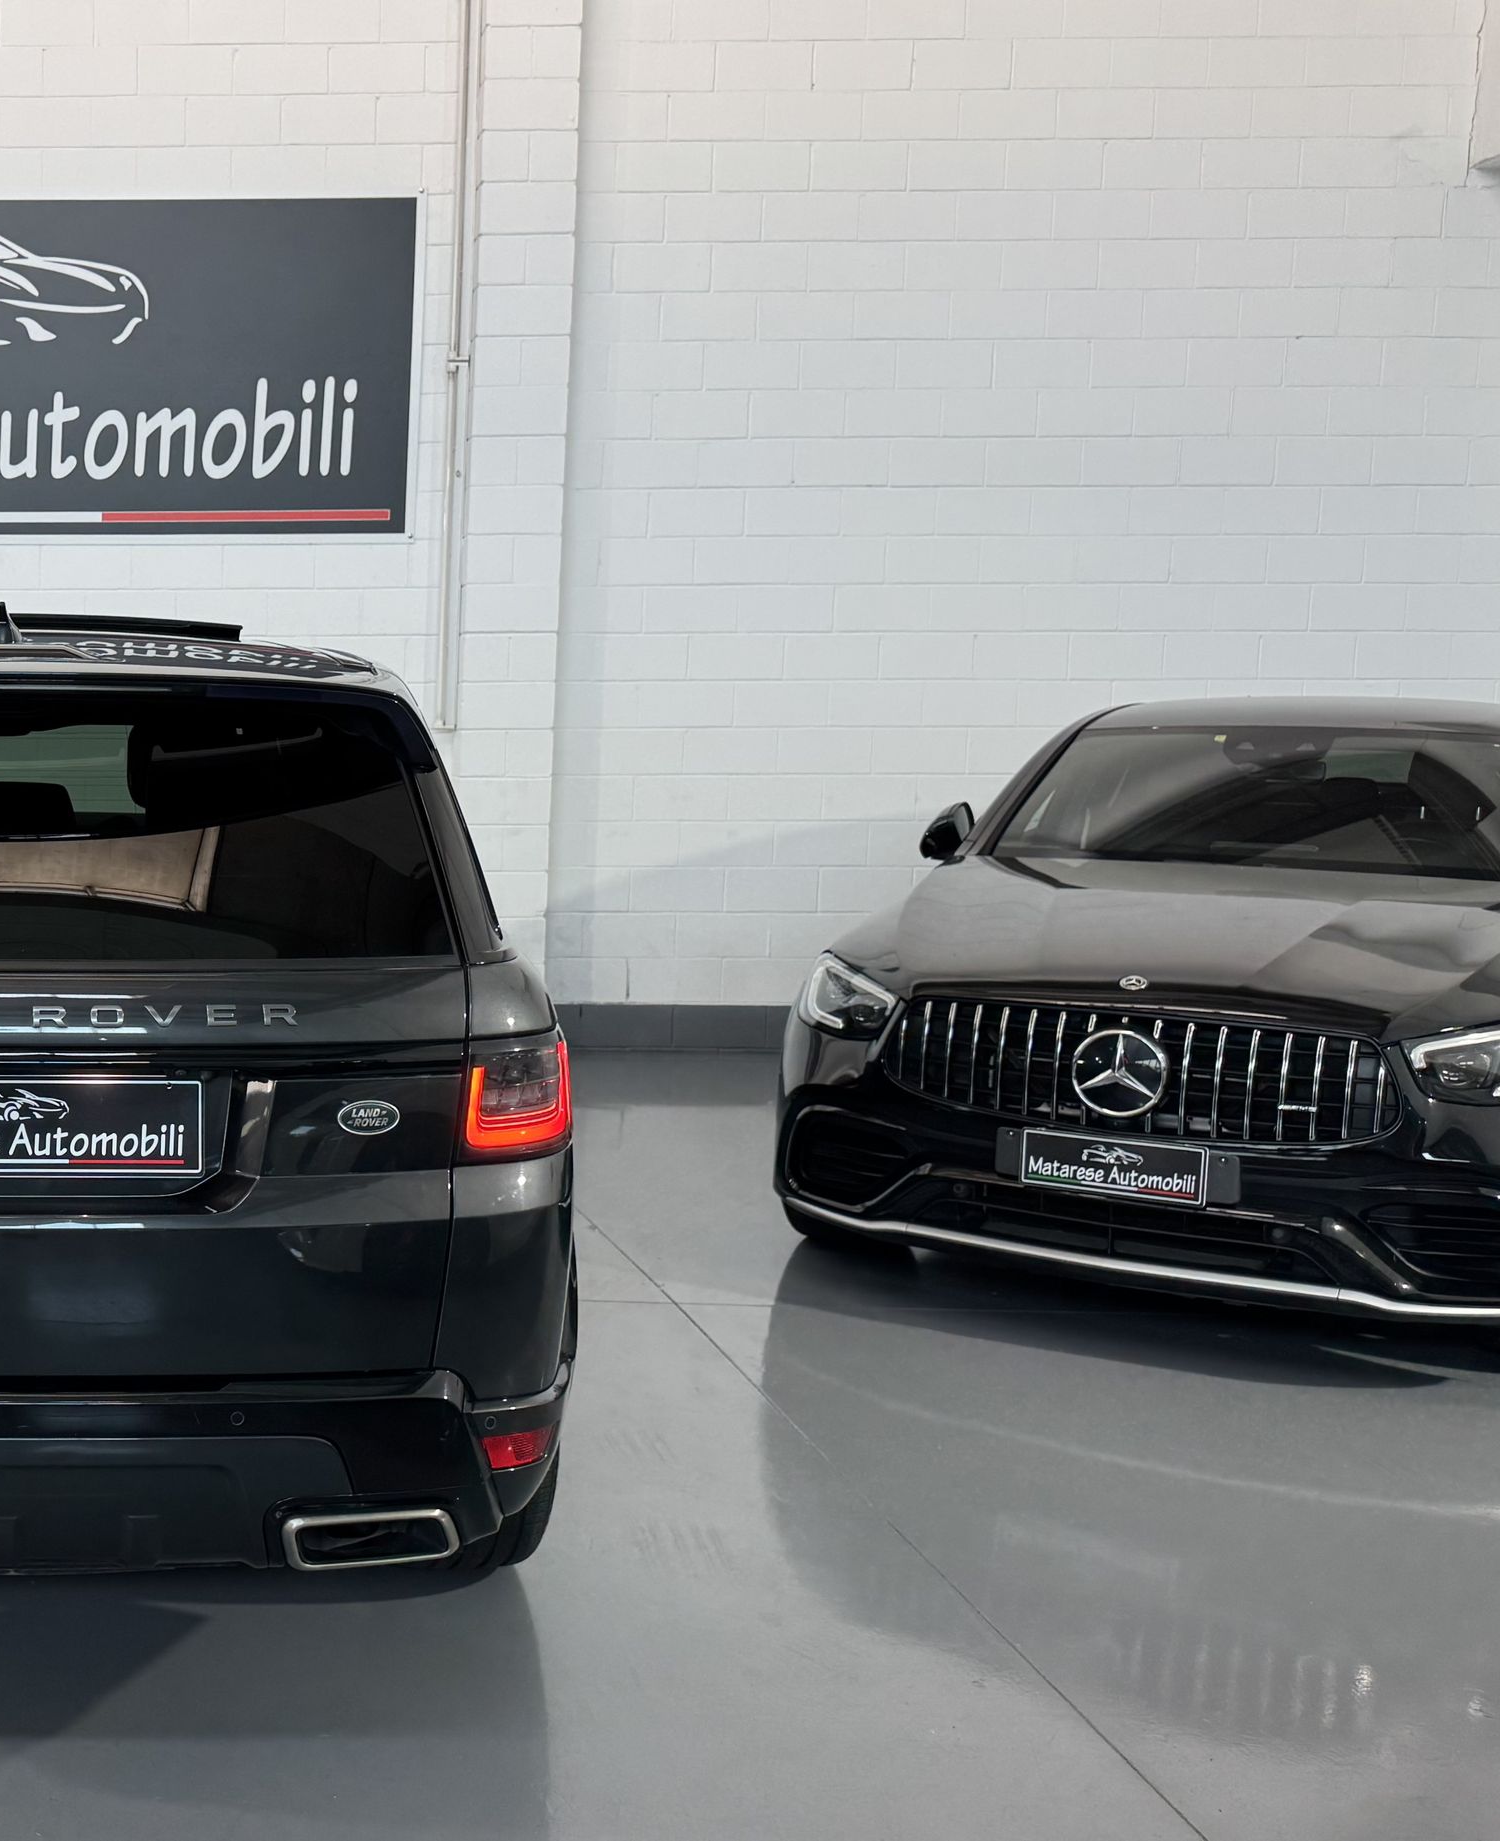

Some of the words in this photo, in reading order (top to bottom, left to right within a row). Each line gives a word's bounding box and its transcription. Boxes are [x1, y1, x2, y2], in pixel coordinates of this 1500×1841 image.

[32, 1004, 299, 1028] ROVER
[351, 1108, 381, 1118] LAND
[353, 1117, 389, 1127] ROVER
[8, 1123, 185, 1157] Automobili
[1027, 1155, 1105, 1183] Matarese
[1107, 1165, 1197, 1194] Automobili
